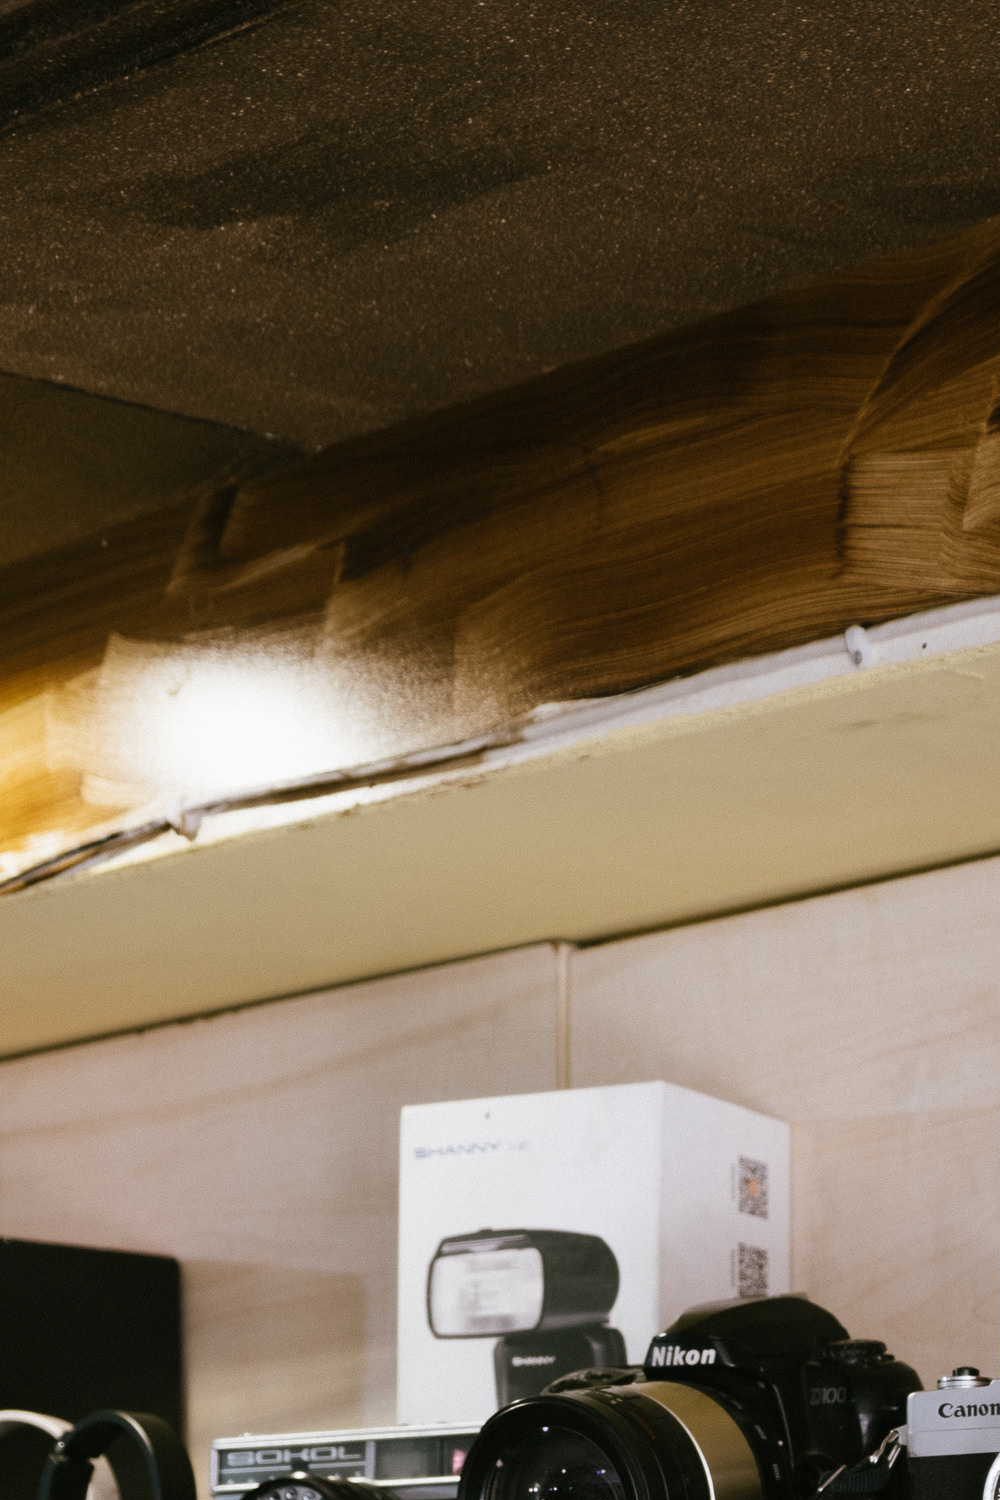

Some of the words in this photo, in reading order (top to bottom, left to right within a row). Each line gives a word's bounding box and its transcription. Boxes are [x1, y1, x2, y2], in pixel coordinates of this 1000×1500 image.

[651, 1346, 716, 1367] Nikon
[938, 1402, 1000, 1419] Canon
[227, 1446, 362, 1466] SOKOL
